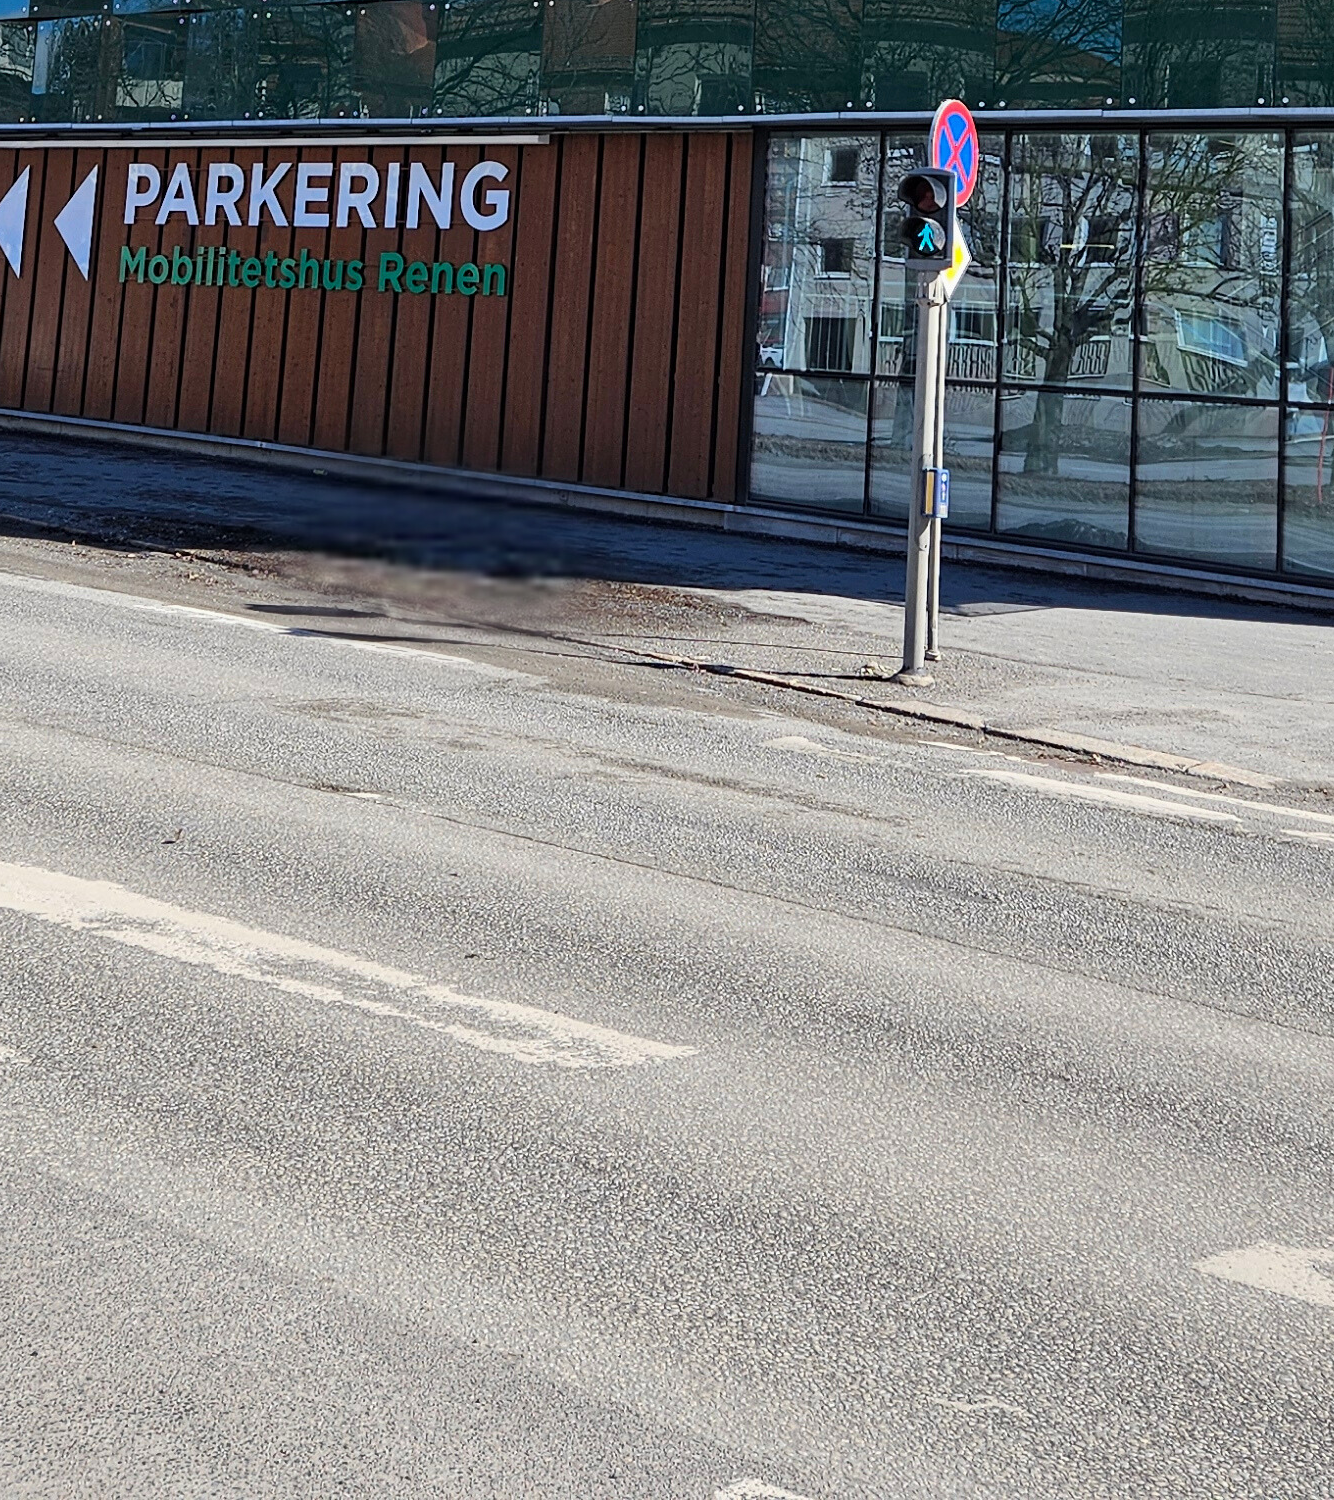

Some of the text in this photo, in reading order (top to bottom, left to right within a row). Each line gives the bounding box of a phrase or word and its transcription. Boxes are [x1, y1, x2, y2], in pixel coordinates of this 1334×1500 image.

[123, 161, 510, 231] PARKERING
[118, 246, 506, 296] Mobilitetshus Renen
